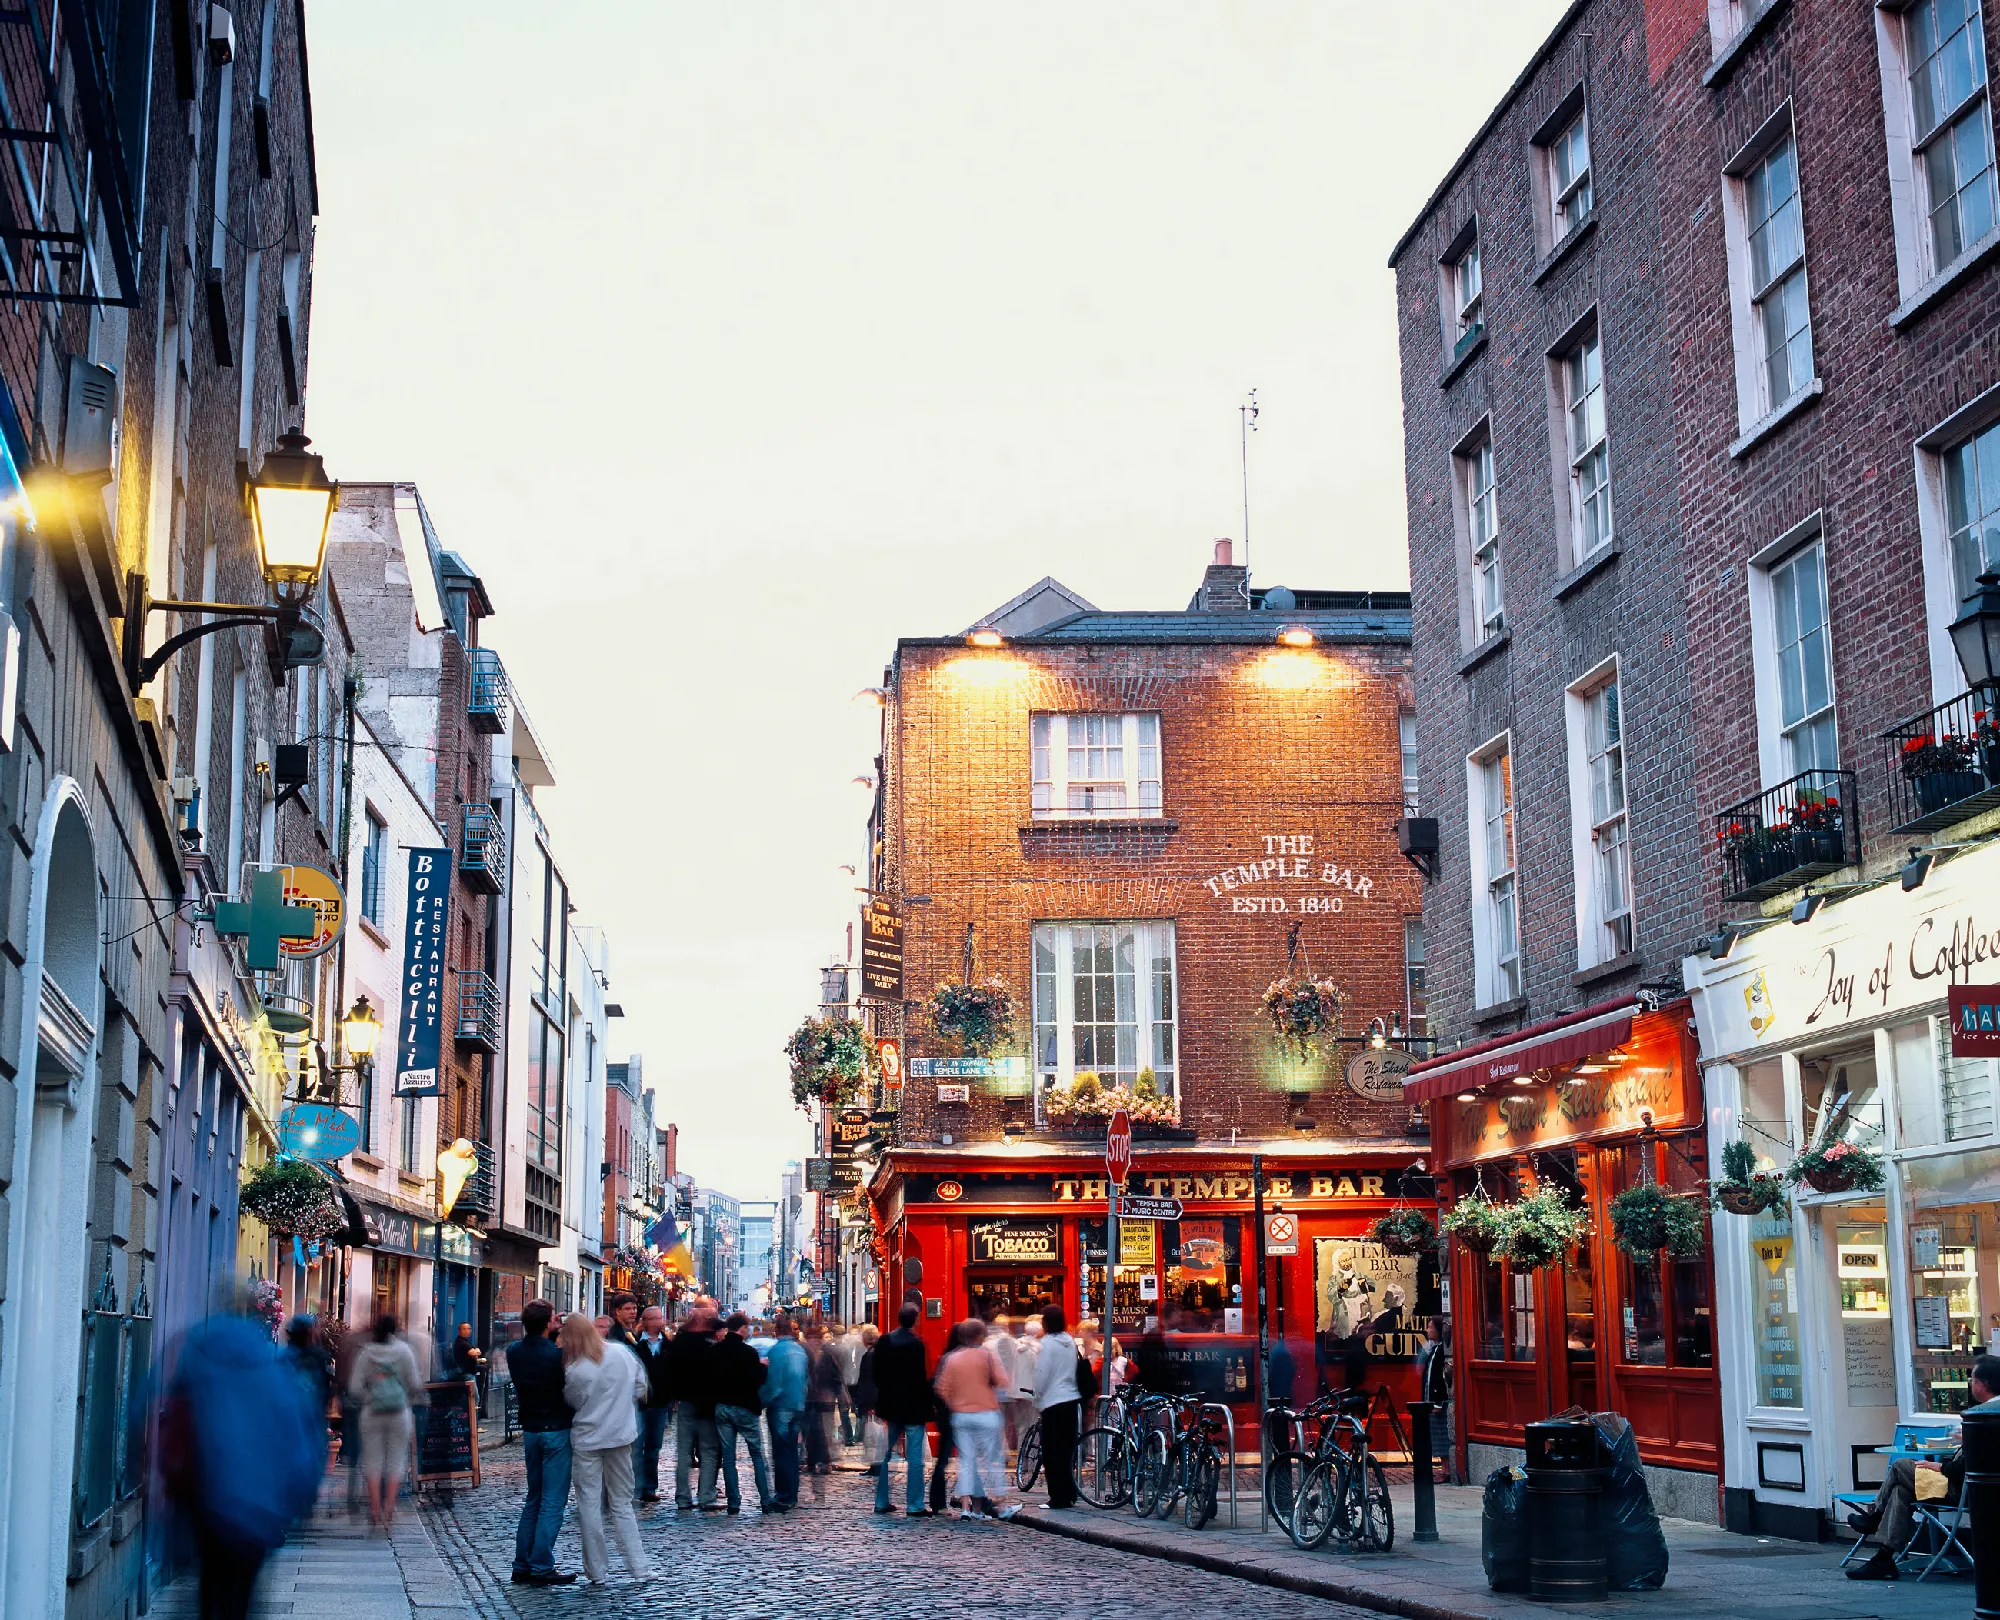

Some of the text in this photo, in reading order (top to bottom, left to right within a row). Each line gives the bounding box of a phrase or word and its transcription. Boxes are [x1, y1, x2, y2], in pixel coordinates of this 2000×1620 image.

[1262, 835, 1314, 855] THE
[1202, 858, 1373, 898] TEMPLE BAR
[875, 901, 890, 912] THE
[1298, 897, 1343, 913] 1840
[315, 914, 339, 922] HOTO
[863, 907, 903, 929] TEMPLE
[871, 920, 895, 938] BAR
[406, 855, 433, 1067] Botticelli
[426, 897, 443, 1027] RESTAURANT
[866, 972, 899, 985] LIVE MUSIC
[1805, 947, 1855, 1024] Joy
[1868, 941, 1893, 1007] of
[934, 1067, 960, 1075] TEMPLE
[961, 1067, 980, 1075] LANE
[1363, 1060, 1380, 1076] The
[1362, 1075, 1404, 1091] Restaura
[314, 1111, 348, 1132] Med
[840, 1130, 865, 1142] BA
[1108, 1133, 1130, 1163] STOP
[942, 1183, 958, 1196] 48
[1145, 1177, 1293, 1200] TEMPLE
[1310, 1176, 1386, 1197] BAR
[1131, 1207, 1176, 1216] MUSIC CENTRE
[1135, 1200, 1173, 1209] TEMPLE BAR
[981, 1234, 1049, 1258] TOBACCO
[1123, 1235, 1137, 1243] MUSIC
[1370, 1259, 1402, 1273] BAR
[1844, 1254, 1877, 1265] OPEN
[1097, 1306, 1149, 1315] LIE MUSIC
[1364, 1332, 1432, 1356] GUIN
[1194, 1351, 1220, 1361] BAR
